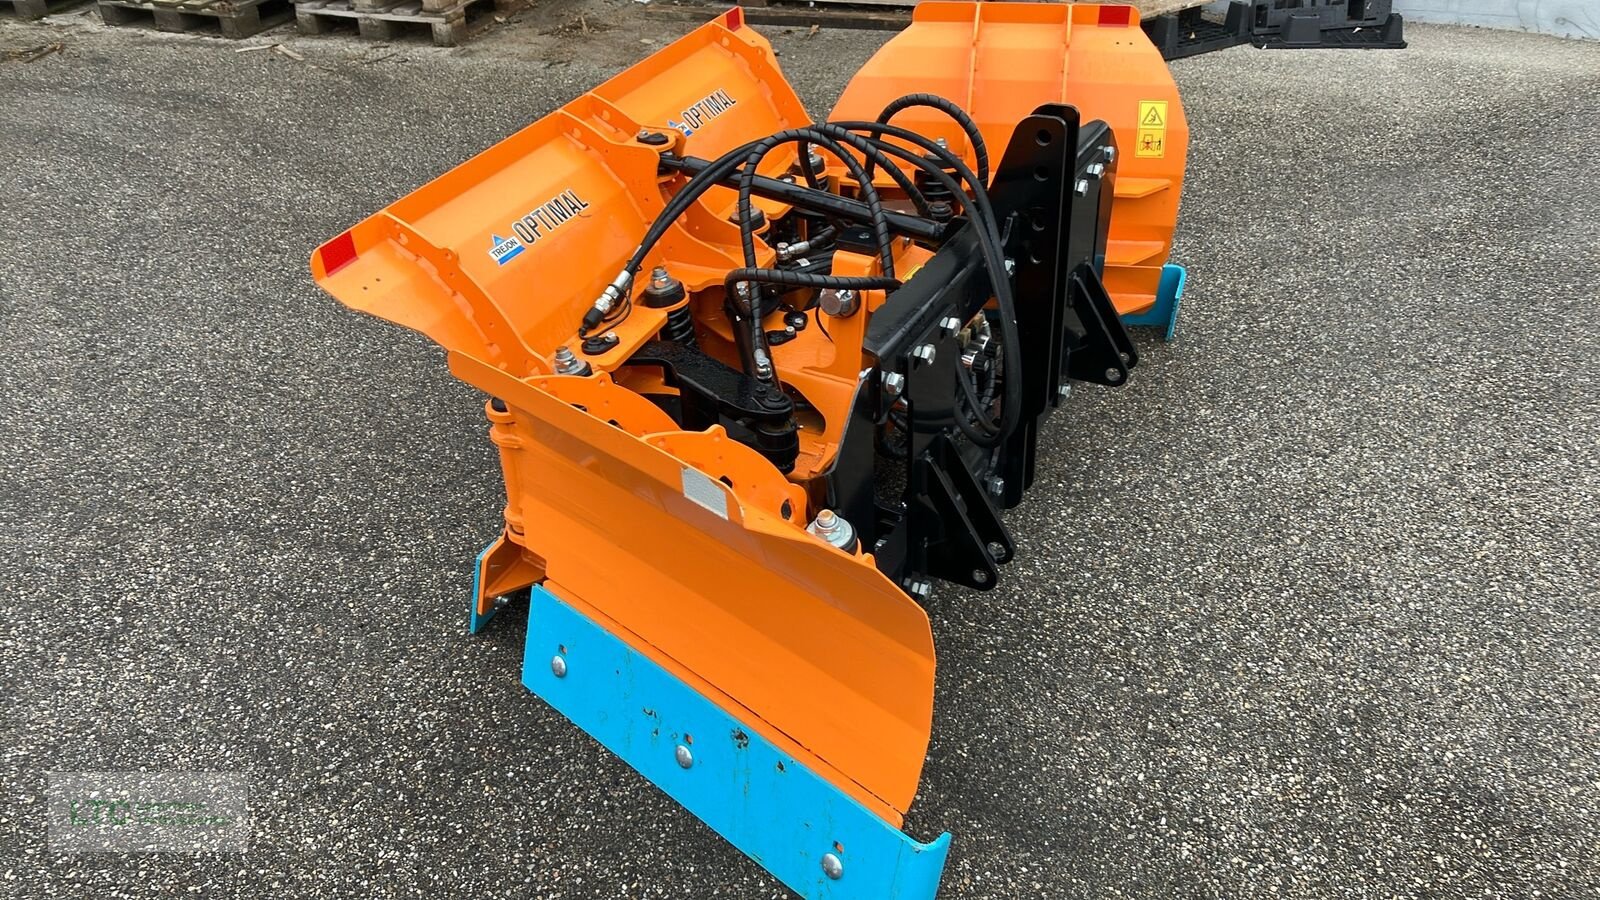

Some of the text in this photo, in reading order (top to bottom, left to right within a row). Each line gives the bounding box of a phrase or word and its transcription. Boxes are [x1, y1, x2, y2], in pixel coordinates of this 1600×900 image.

[682, 88, 737, 129] OPTIMAL
[491, 189, 589, 258] TREJON OPTIMAL
